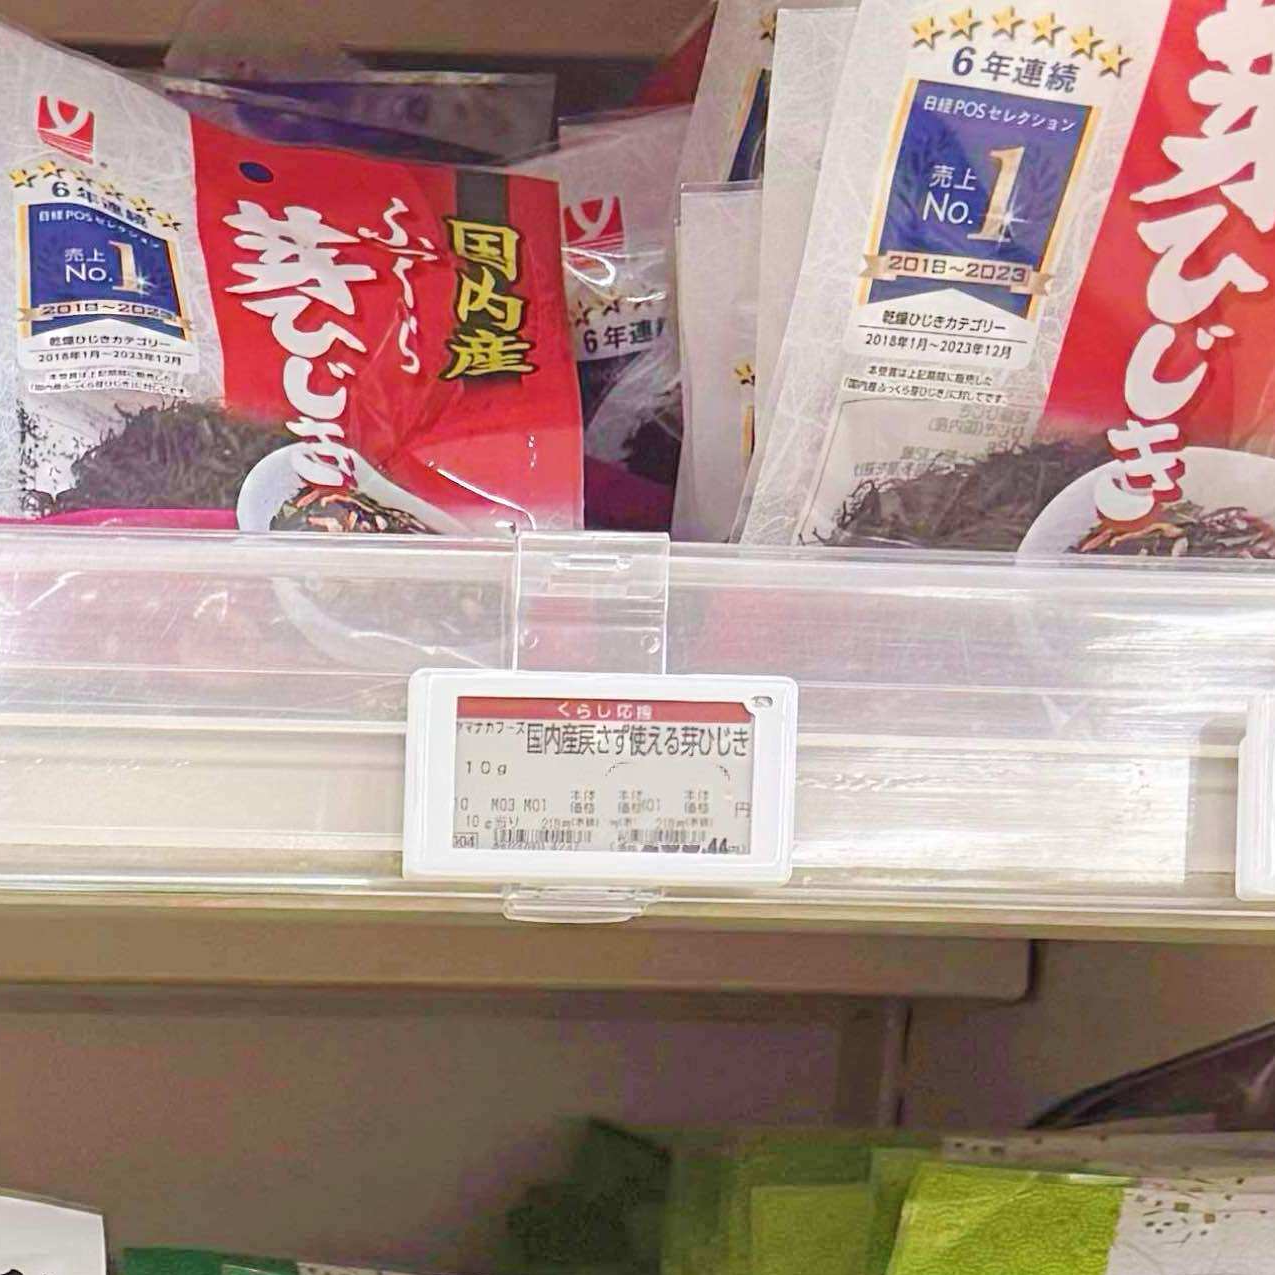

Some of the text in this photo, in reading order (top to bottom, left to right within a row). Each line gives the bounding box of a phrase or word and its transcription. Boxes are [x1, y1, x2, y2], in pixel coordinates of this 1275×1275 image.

[952, 46, 1080, 94] 6年連続
[923, 96, 1077, 132] 日経POSセレクション
[929, 164, 978, 191] 売上
[65, 248, 106, 263] 売上
[359, 198, 441, 374] ふっくら
[442, 216, 534, 380] 国内産
[882, 309, 1007, 333] 乾燥ひじきカテゴリー
[225, 199, 377, 487] 芽ひじき
[558, 703, 652, 720] くらし応援
[527, 722, 749, 757] 国内産戻さず使える芽ひじき
[464, 761, 507, 776] 10g
